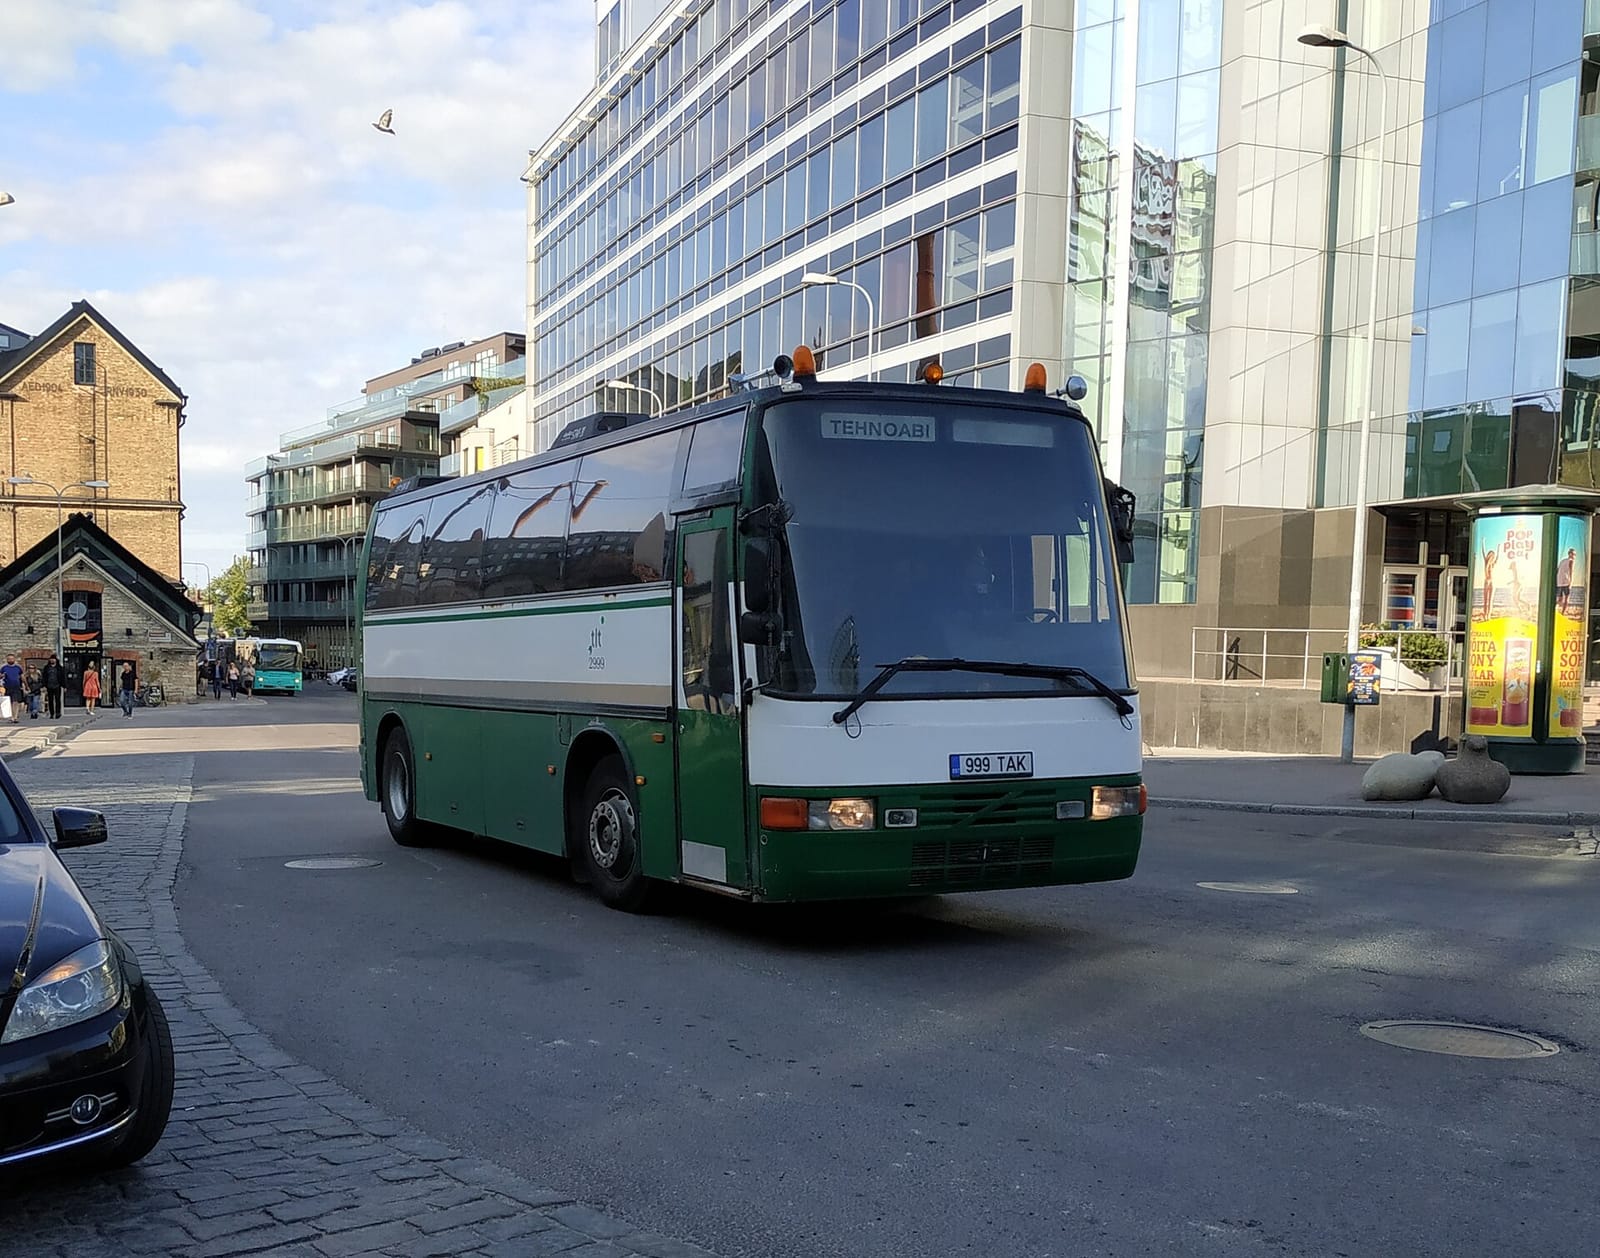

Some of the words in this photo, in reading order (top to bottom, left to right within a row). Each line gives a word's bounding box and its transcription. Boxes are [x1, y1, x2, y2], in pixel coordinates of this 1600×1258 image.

[830, 420, 930, 438] TEHNOABI
[589, 656, 605, 670] 2999
[965, 757, 990, 773] 999
[997, 755, 1026, 772] TAK
